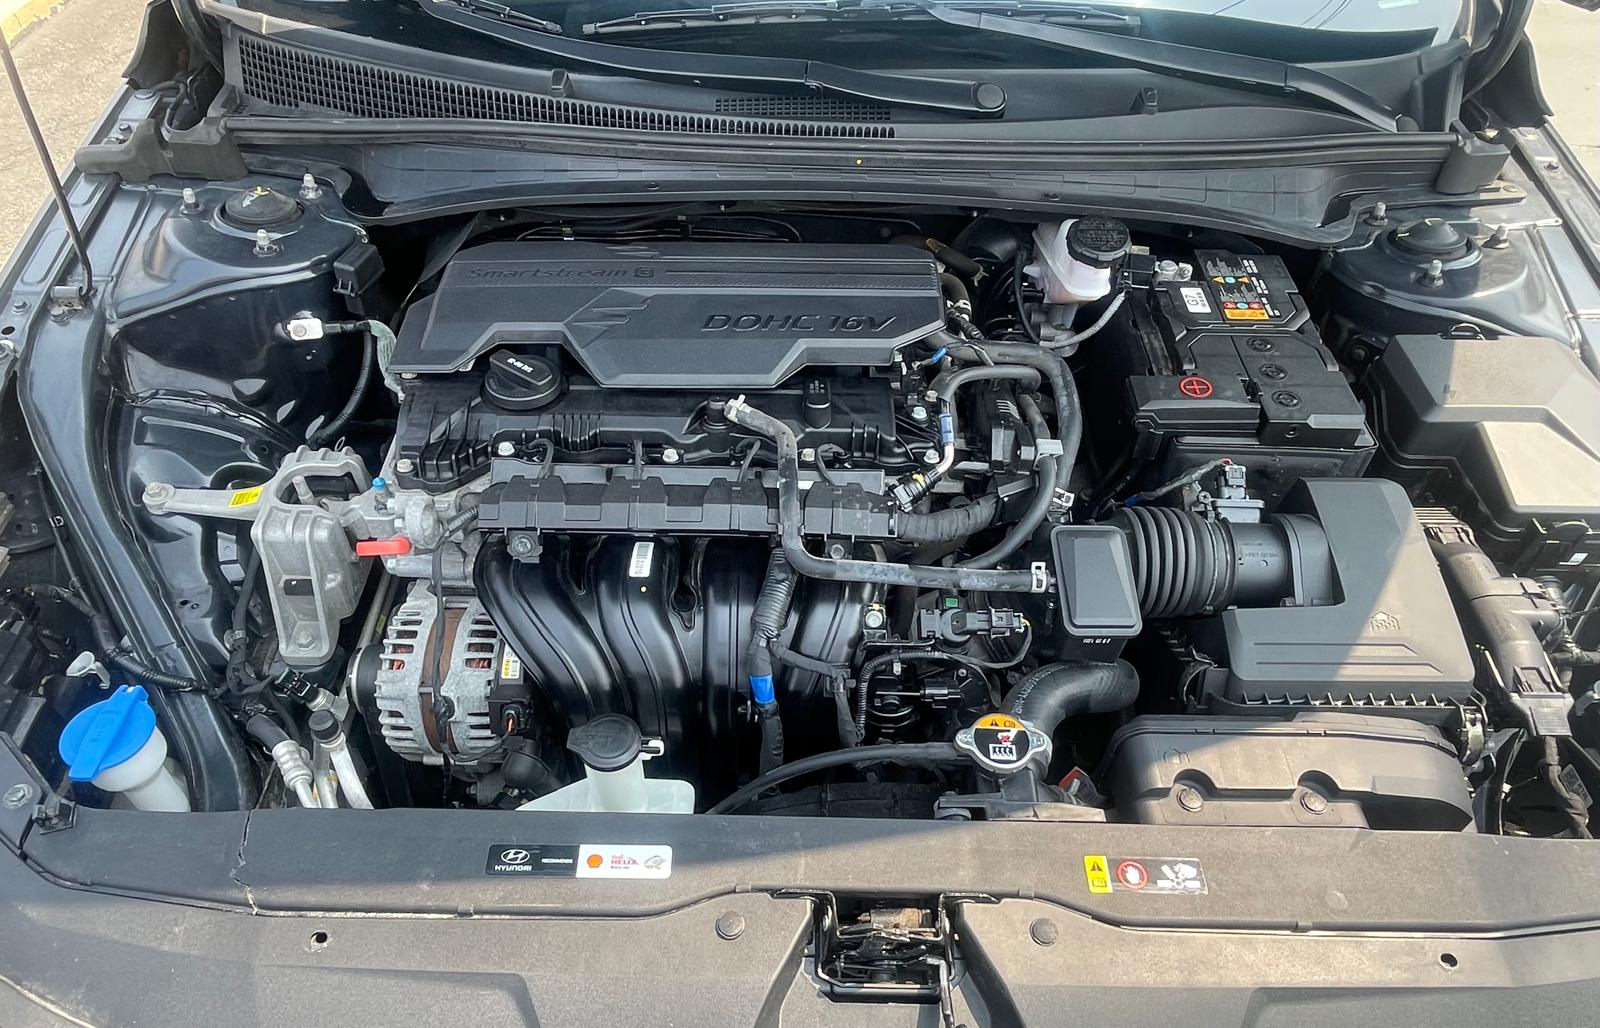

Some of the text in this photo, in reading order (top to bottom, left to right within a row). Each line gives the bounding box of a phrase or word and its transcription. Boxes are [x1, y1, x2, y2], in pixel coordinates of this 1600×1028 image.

[466, 267, 629, 279] Smartstream
[701, 314, 897, 332] DOHC 16V
[494, 864, 533, 872] HYUNDAI
